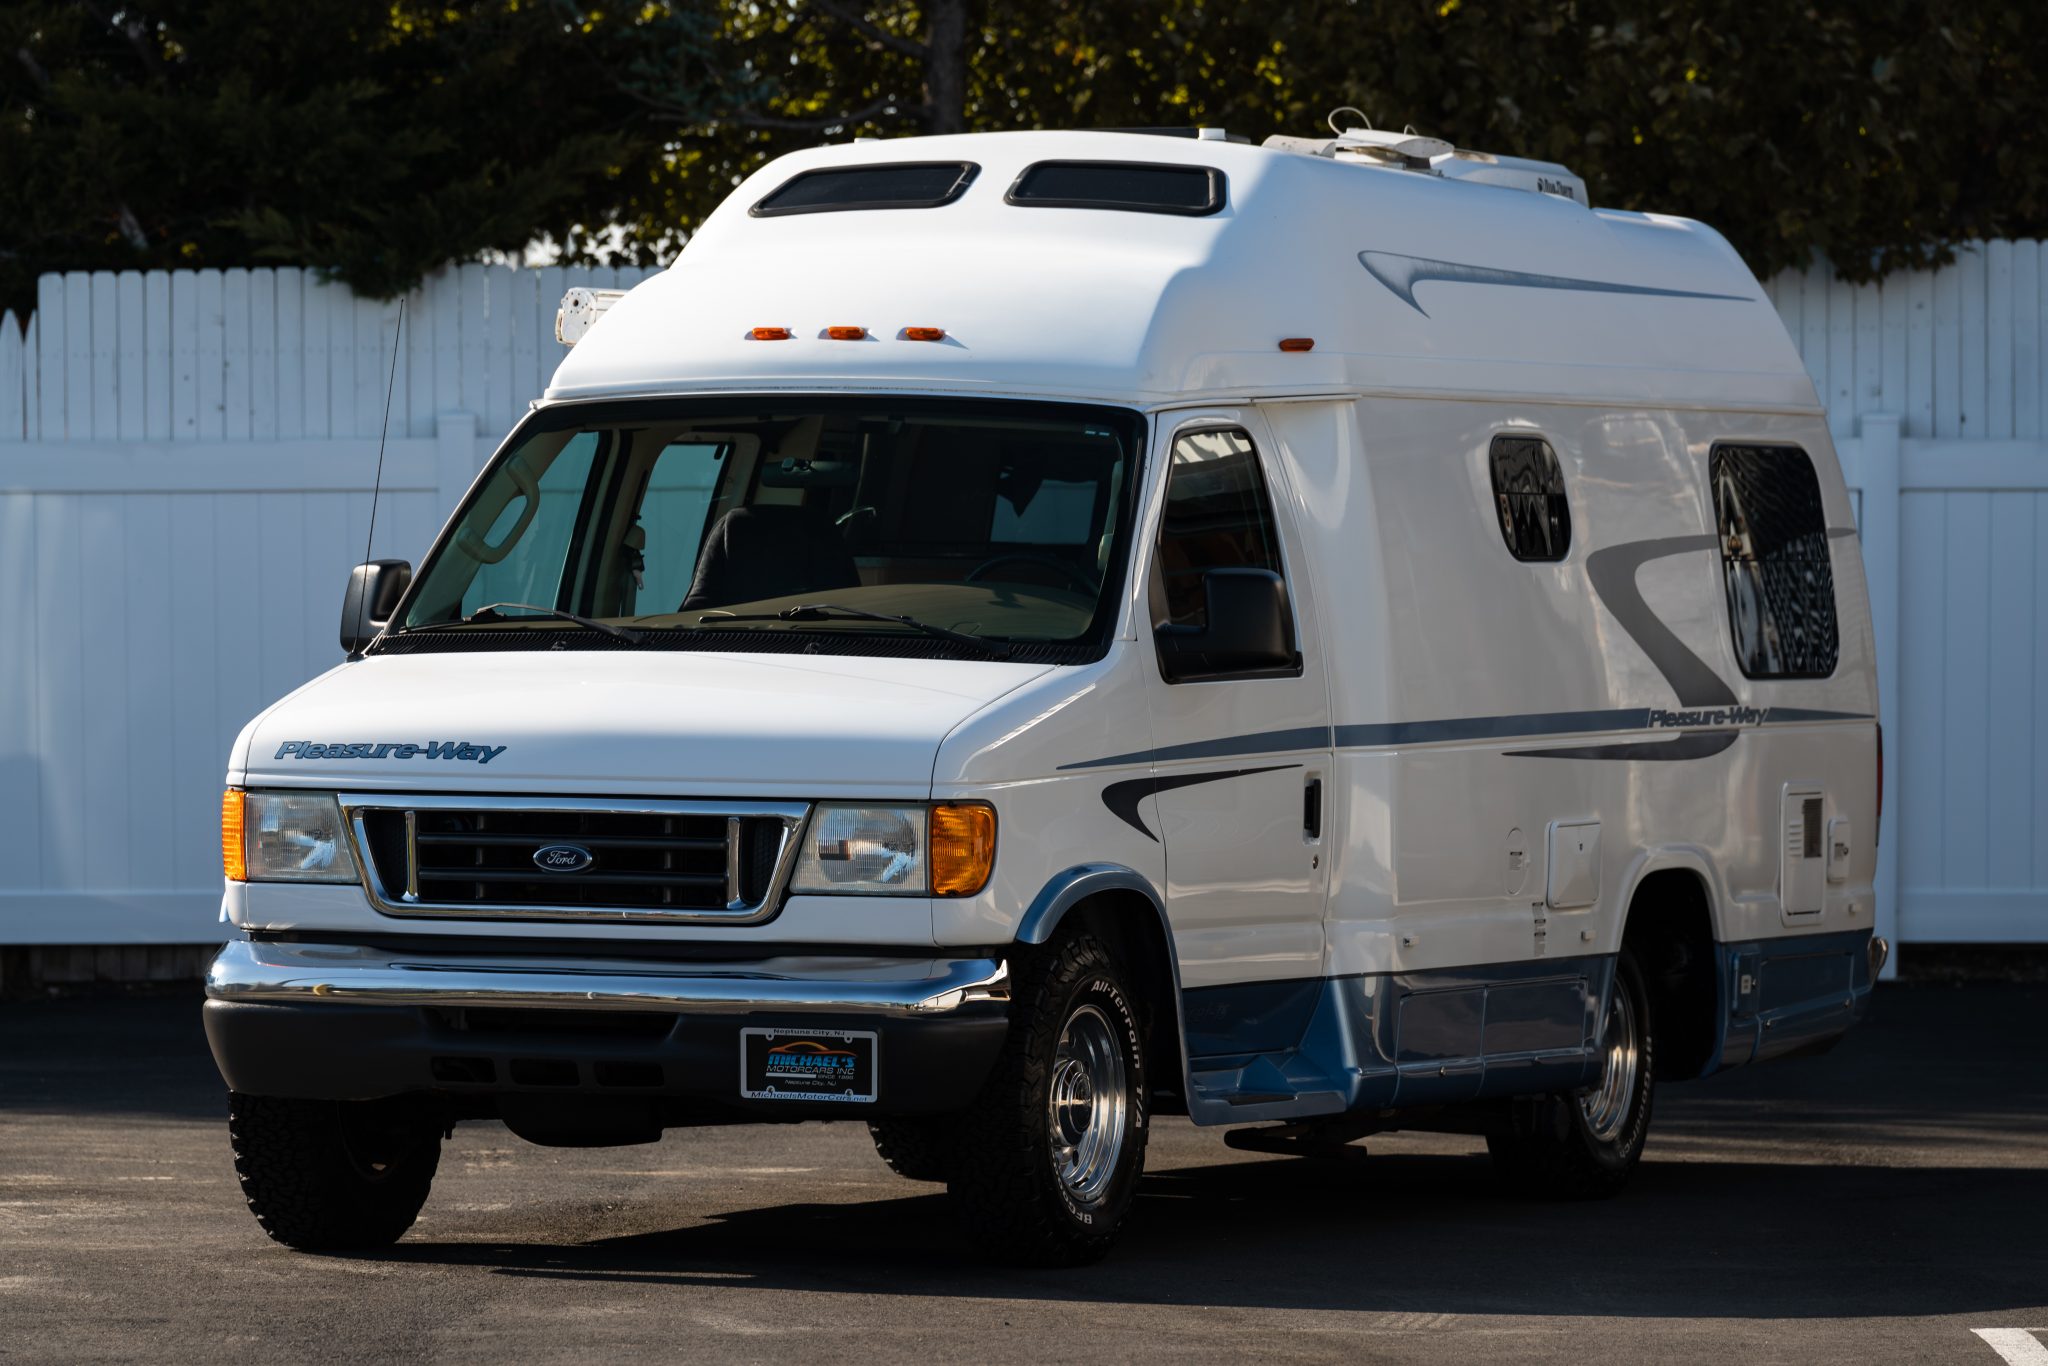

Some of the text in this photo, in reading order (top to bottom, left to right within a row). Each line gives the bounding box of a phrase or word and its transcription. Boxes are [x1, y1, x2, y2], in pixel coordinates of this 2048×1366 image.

[1648, 706, 1767, 728] Pleasure-Way
[274, 741, 507, 763] Pleasure-Way
[546, 850, 577, 865] Ford
[768, 1054, 856, 1068] MICHAEL'S
[766, 1066, 855, 1075] MOTORCARS INC
[1135, 1084, 1143, 1128] T/A
